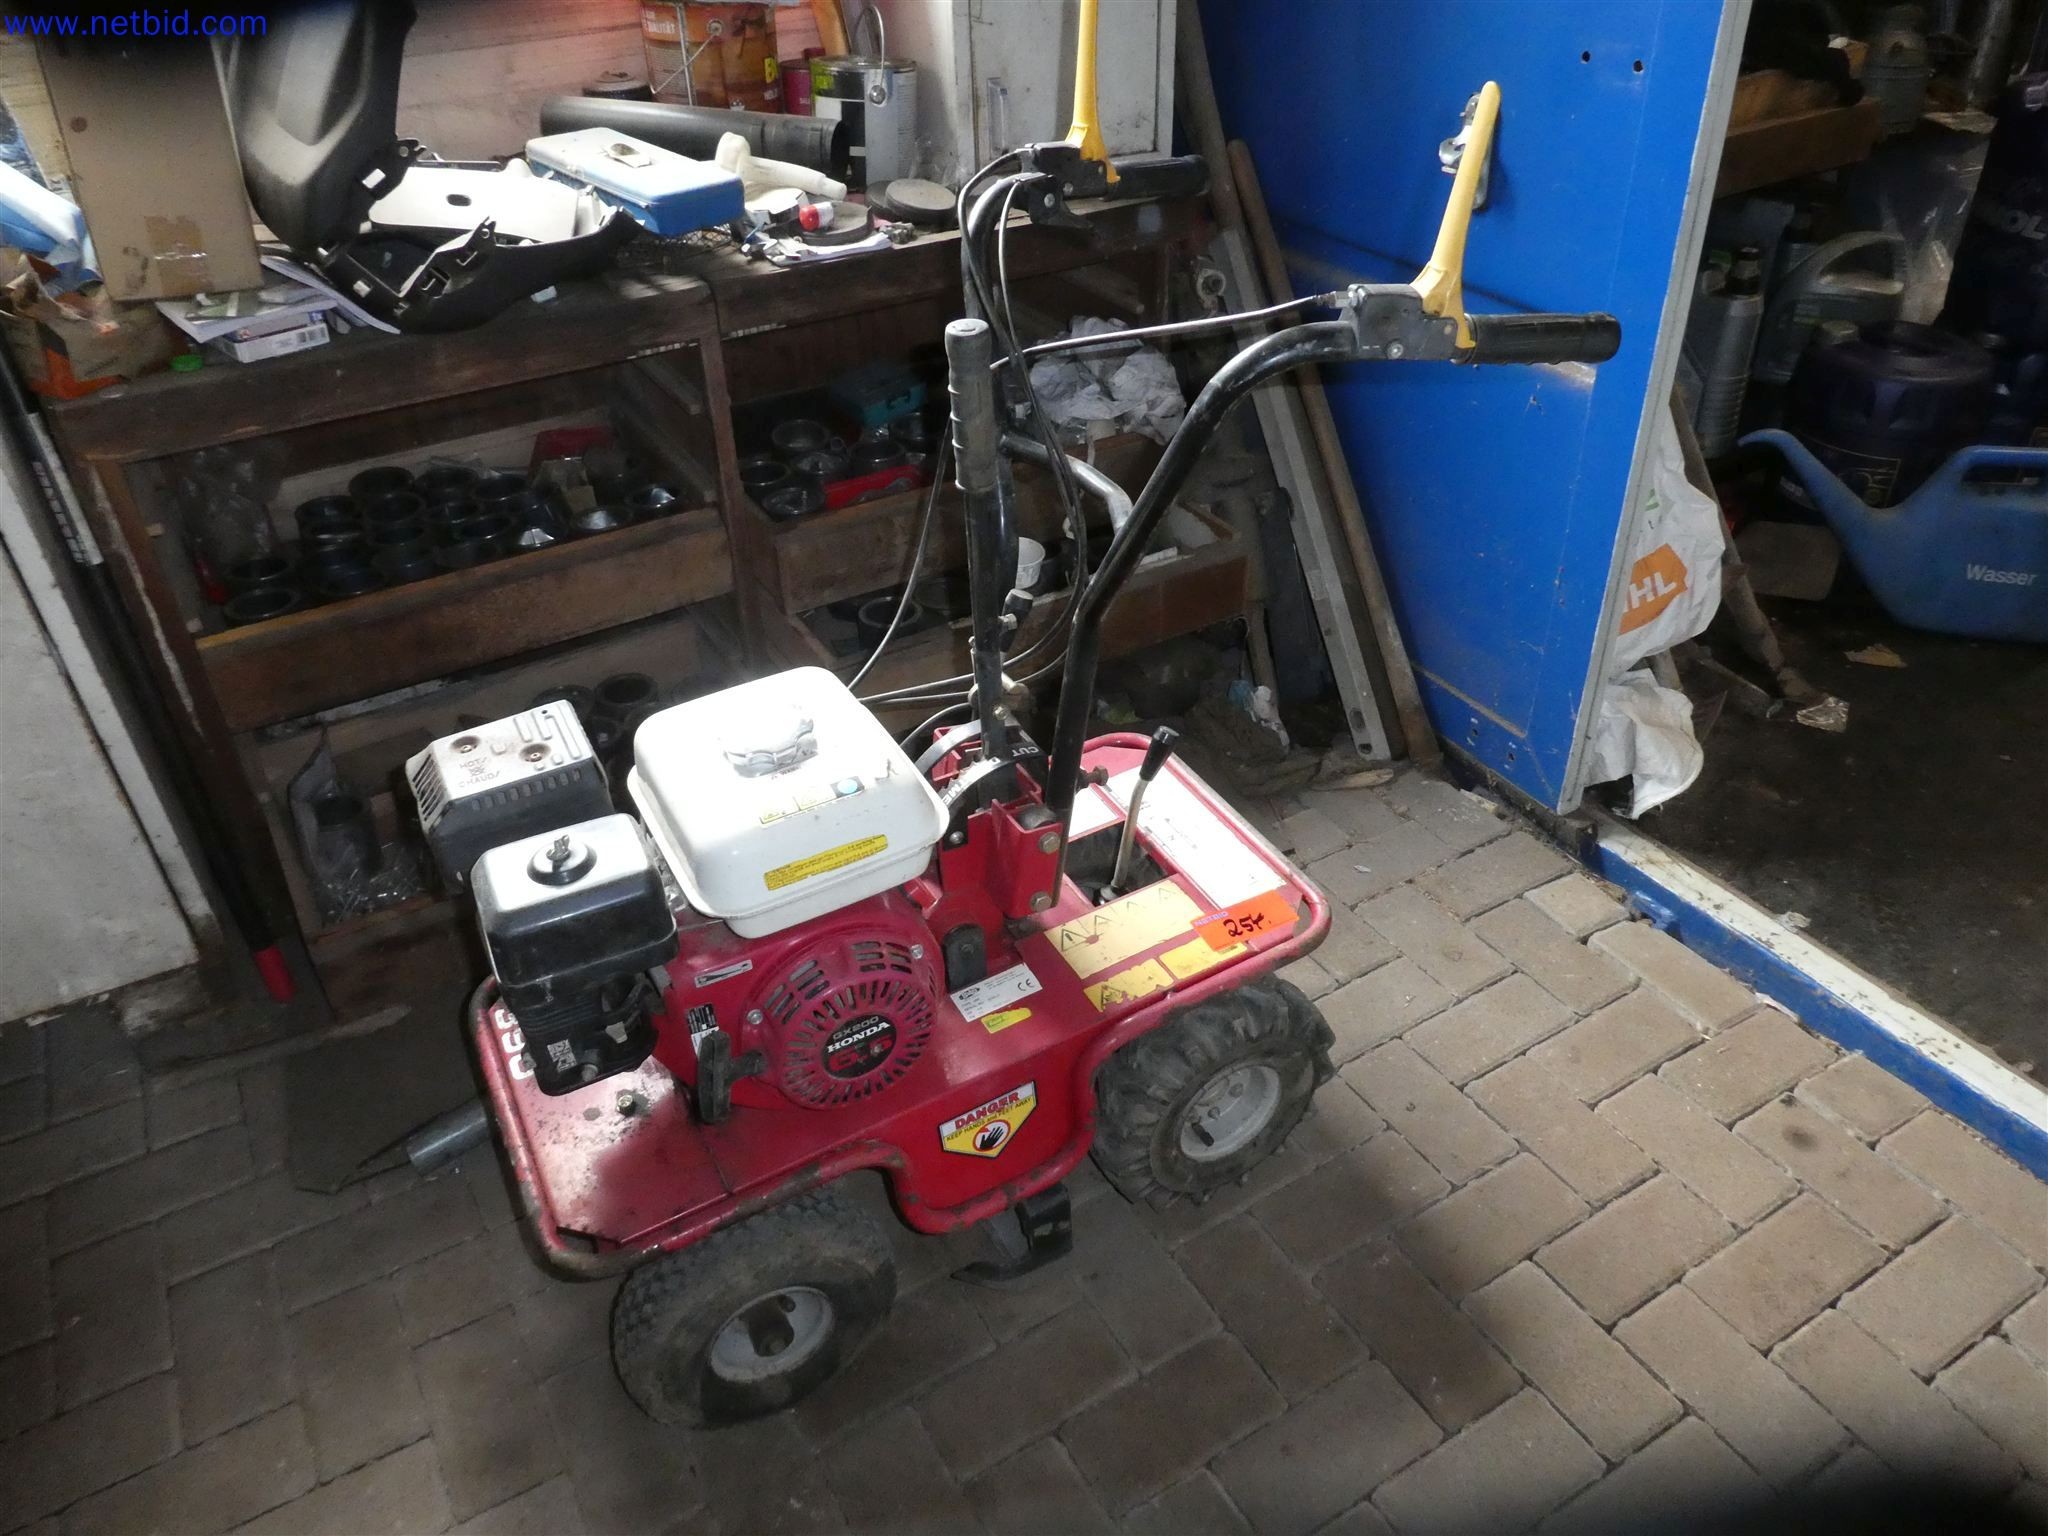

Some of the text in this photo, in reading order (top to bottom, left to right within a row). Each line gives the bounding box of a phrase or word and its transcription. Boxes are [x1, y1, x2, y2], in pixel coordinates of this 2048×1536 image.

[1967, 563, 2039, 586] Wasser
[827, 1022, 891, 1053] HONDA
[833, 1015, 879, 1040] GX200
[946, 1130, 963, 1141] KEEP
[964, 1119, 985, 1133] HANDS
[1015, 1098, 1032, 1109] AWAY
[954, 1091, 1020, 1130] DANGER
